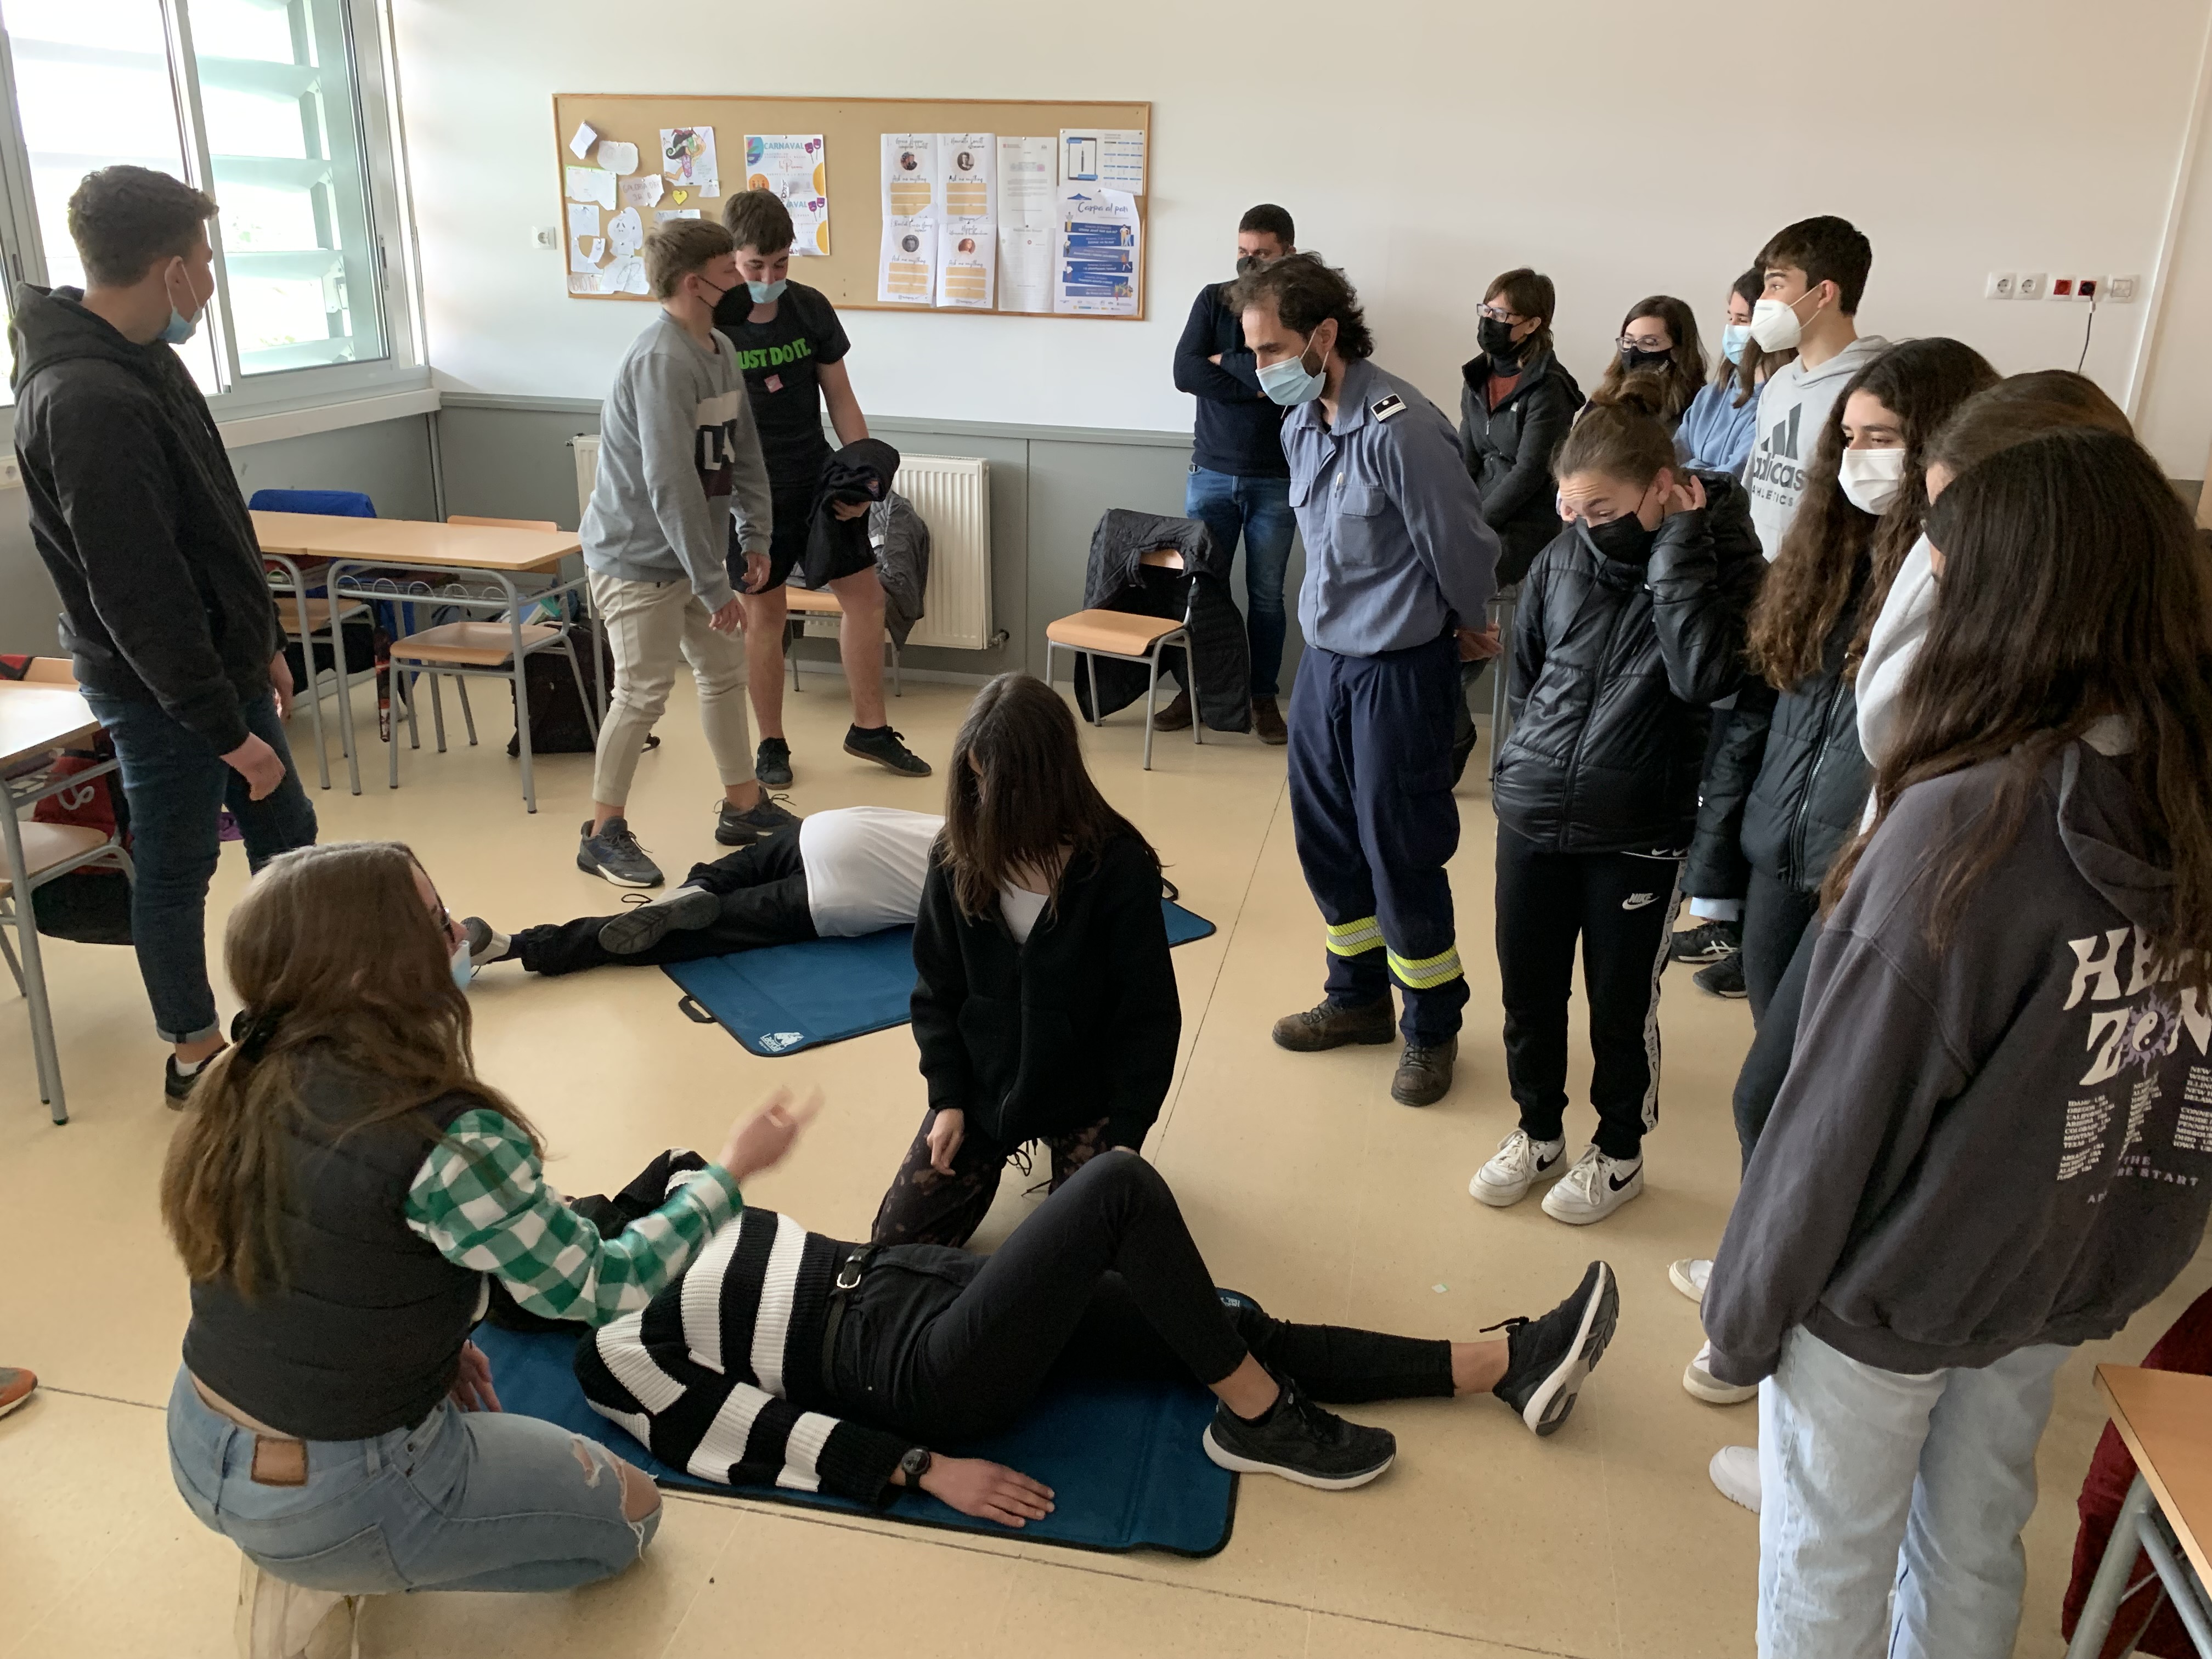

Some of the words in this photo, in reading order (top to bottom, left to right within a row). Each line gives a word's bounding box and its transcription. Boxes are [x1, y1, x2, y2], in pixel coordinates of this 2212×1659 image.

[1077, 201, 1103, 215] Carpa
[1105, 203, 1113, 213] al
[1114, 205, 1128, 215] pati
[737, 349, 767, 369] UST
[770, 345, 794, 365] DO
[1629, 893, 1654, 904] NIKE
[761, 1032, 785, 1052] Laerdal
[2140, 1167, 2199, 1186] START
